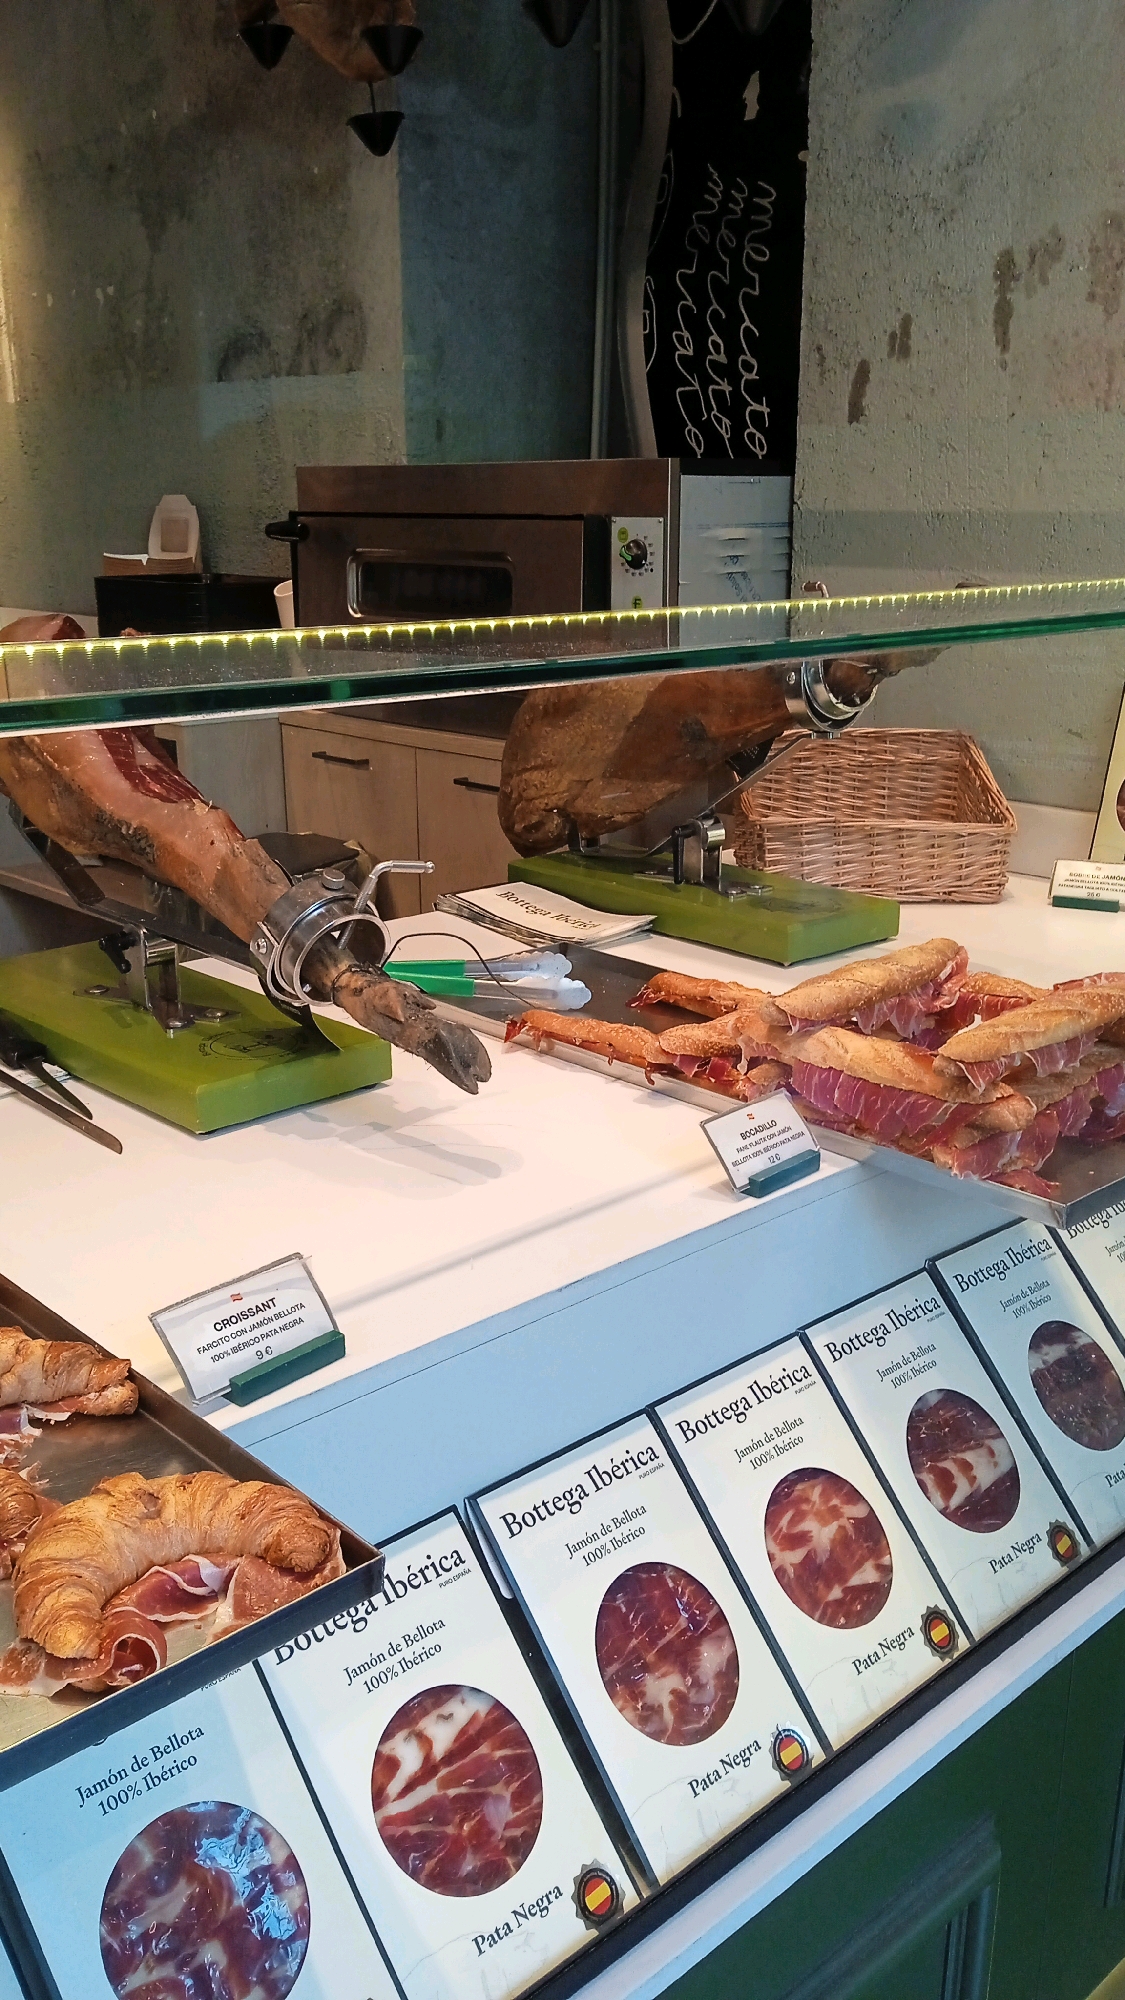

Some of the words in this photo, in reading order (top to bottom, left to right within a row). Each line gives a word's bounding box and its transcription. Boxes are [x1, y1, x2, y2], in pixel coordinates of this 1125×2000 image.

[672, 163, 723, 458] mercato
[706, 178, 748, 459] mercato
[738, 181, 777, 459] mercato
[497, 891, 551, 916] Bottega
[740, 1119, 777, 1140] BOCADILLO
[953, 1259, 1010, 1293] Bottega
[1004, 1238, 1052, 1267] Ibérica
[213, 1297, 277, 1332] CROISSANT
[1000, 1293, 1021, 1312] Jamón
[1020, 1289, 1029, 1299] de
[1028, 1280, 1050, 1295] Bellota
[1012, 1303, 1031, 1319] 100%
[1029, 1294, 1051, 1310] Ibérico
[197, 1335, 230, 1355] FARCITO
[230, 1327, 248, 1341] CON
[248, 1315, 274, 1333] JAMÓN
[274, 1302, 306, 1322] BELLOTA
[210, 1350, 231, 1363] 100%
[231, 1335, 261, 1355] IBÉRICO
[261, 1327, 279, 1343] PATA
[279, 1316, 304, 1334] NEGRA
[256, 1349, 264, 1360] 9
[265, 1346, 273, 1356] €
[824, 1323, 891, 1363] Bottega
[885, 1296, 941, 1331] Ibérica
[876, 1360, 902, 1382] Jamón
[902, 1354, 911, 1366] de
[910, 1343, 937, 1361] Bellota
[891, 1370, 913, 1389] 100%
[911, 1359, 937, 1378] Ibérico
[675, 1396, 753, 1444] Bottega
[747, 1365, 812, 1405] Ibérica
[734, 1438, 764, 1463] Jamón
[764, 1431, 775, 1443] de
[773, 1416, 804, 1438] Bellota
[749, 1448, 775, 1471] 100%
[773, 1435, 804, 1458] Ibérico
[499, 1483, 590, 1539] Bottega
[584, 1446, 660, 1492] Ibérica
[565, 1531, 600, 1559] Jamón
[600, 1523, 612, 1537] de
[611, 1505, 647, 1530] Bellota
[582, 1542, 612, 1567] 100%
[609, 1526, 646, 1551] Ibérico
[988, 1553, 1014, 1574] Pata
[1010, 1533, 1042, 1558] Negra
[439, 1577, 454, 1589] PURO
[453, 1568, 472, 1582] ESPAÑA
[343, 1652, 387, 1686] Jamón
[388, 1642, 401, 1657] de
[401, 1618, 446, 1649] Bellota
[362, 1665, 399, 1694] 100%
[397, 1642, 442, 1674] Ibérico
[852, 1650, 881, 1676] Pata
[878, 1626, 915, 1658] Negra
[75, 1769, 129, 1808] Jamón
[130, 1755, 150, 1773] de
[149, 1726, 204, 1762] Bellota
[98, 1781, 143, 1816] 100%
[142, 1755, 198, 1792] Ibérico
[687, 1769, 722, 1798] Pata
[719, 1740, 762, 1776] Negra
[472, 1921, 513, 1957] Pata
[511, 1885, 563, 1929] Negra
